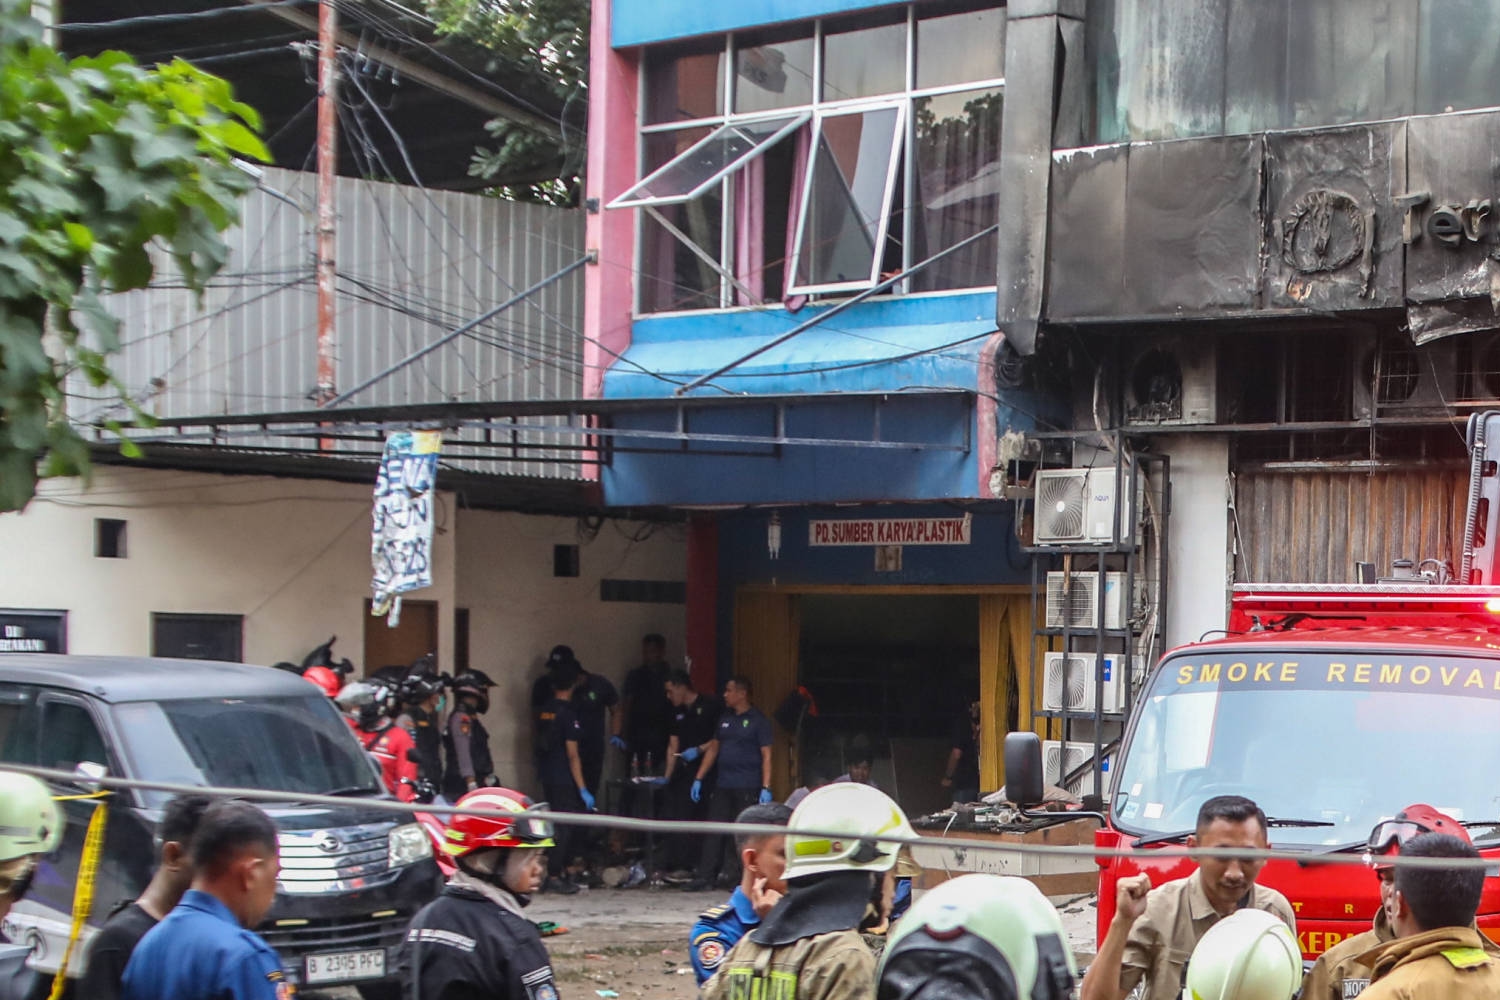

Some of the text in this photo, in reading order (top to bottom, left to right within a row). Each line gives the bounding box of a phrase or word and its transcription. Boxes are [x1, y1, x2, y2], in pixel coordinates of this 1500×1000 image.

[832, 522, 874, 542] SUMBER
[878, 521, 914, 542] KARYA
[917, 520, 964, 542] PLASTIK
[1176, 662, 1298, 685] SMOKE
[309, 958, 317, 973] B
